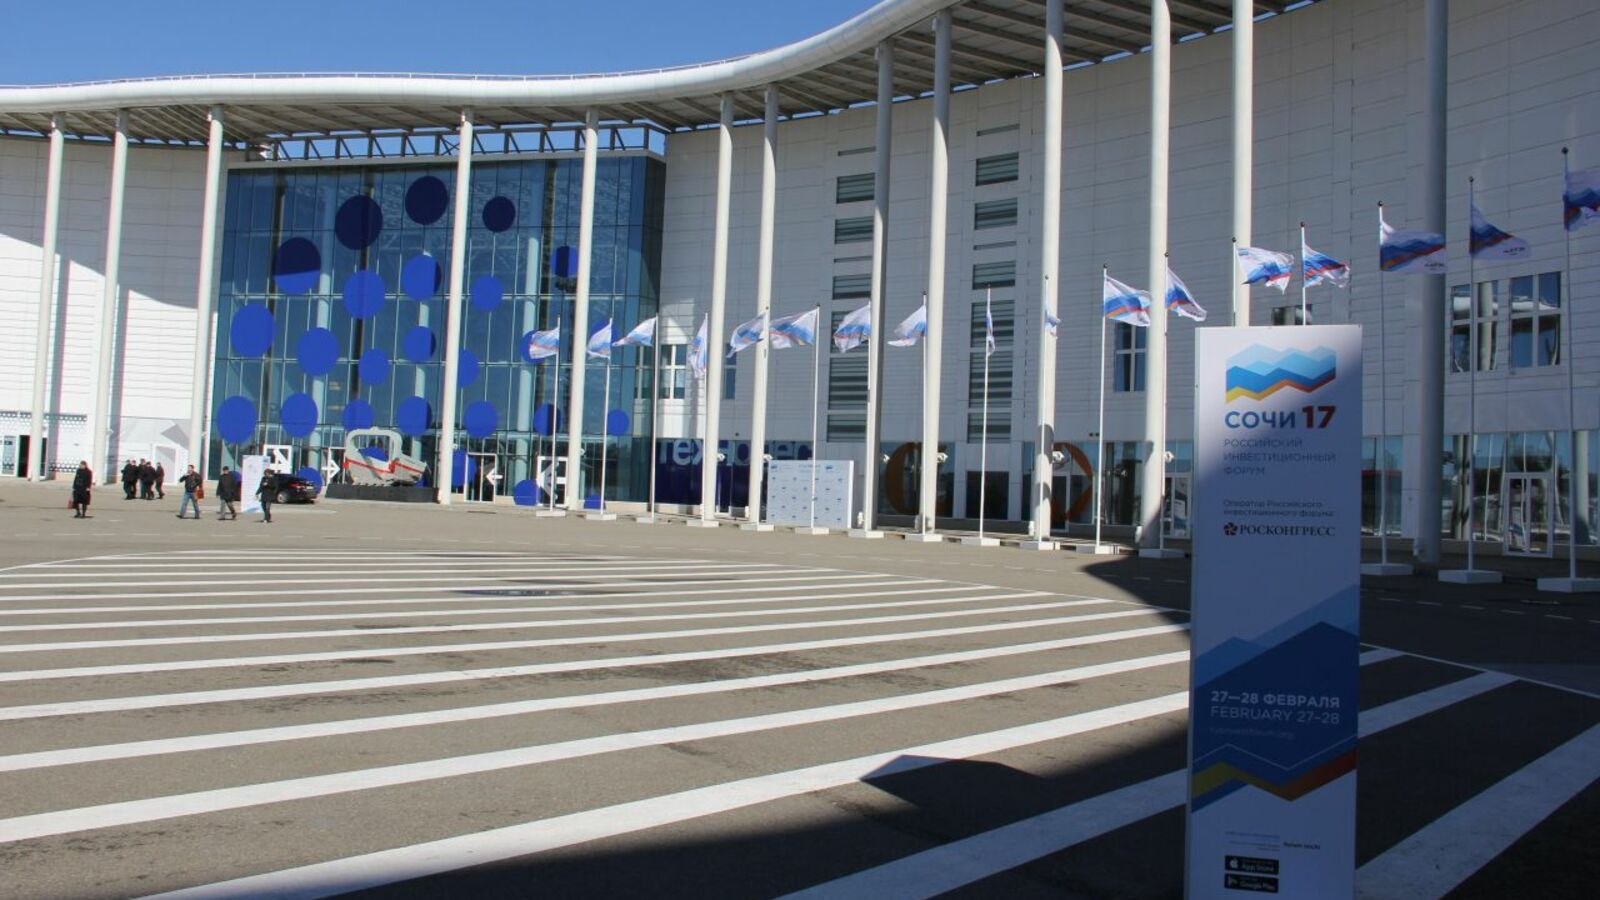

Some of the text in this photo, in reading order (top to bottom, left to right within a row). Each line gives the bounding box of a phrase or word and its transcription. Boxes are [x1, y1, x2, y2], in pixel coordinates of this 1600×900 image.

[1225, 405, 1336, 429] СОЧИ 17
[1224, 437, 1303, 448] РОССИЙСКИЙ
[1224, 451, 1336, 463] ИНВЕСТИЦИОННЫЙ
[1224, 466, 1265, 476] ФОРУМ
[1239, 525, 1336, 537] РОСКОНГРЕСС
[1263, 693, 1340, 709] ФЕВРАЛЯ
[1210, 706, 1293, 721] FEBRUARY
